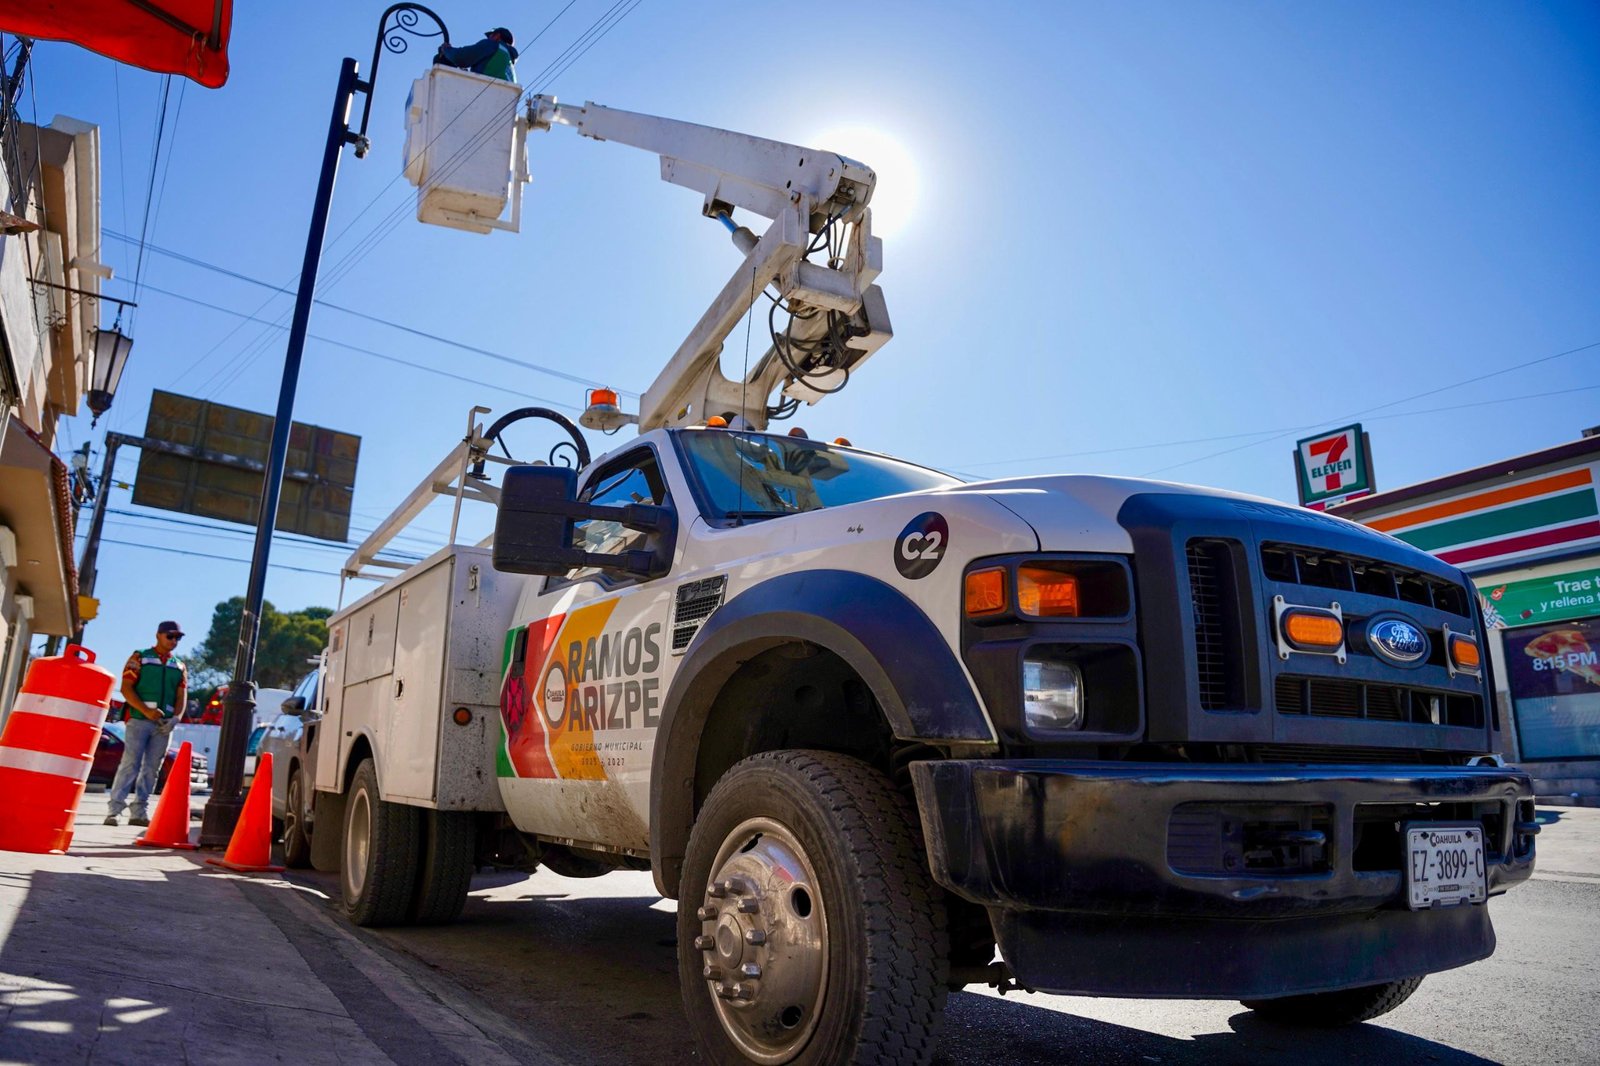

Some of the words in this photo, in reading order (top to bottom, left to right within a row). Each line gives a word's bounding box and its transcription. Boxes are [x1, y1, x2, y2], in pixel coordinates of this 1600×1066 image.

[1309, 433, 1348, 491] 7
[901, 531, 942, 560] C2
[1554, 579, 1592, 594] Trae
[1540, 601, 1548, 612] y
[1551, 594, 1594, 608] rellena
[567, 622, 661, 684] RAMOS
[1532, 655, 1566, 671] 8:15
[1567, 651, 1598, 667] PM
[568, 677, 660, 732] ARIZPE
[570, 742, 603, 752] GOBIERNO
[604, 741, 643, 751] MUNICIPAL
[607, 757, 625, 767] 2027
[1429, 833, 1462, 847] COAHUILA
[1412, 848, 1484, 882] EZ-3899-C
